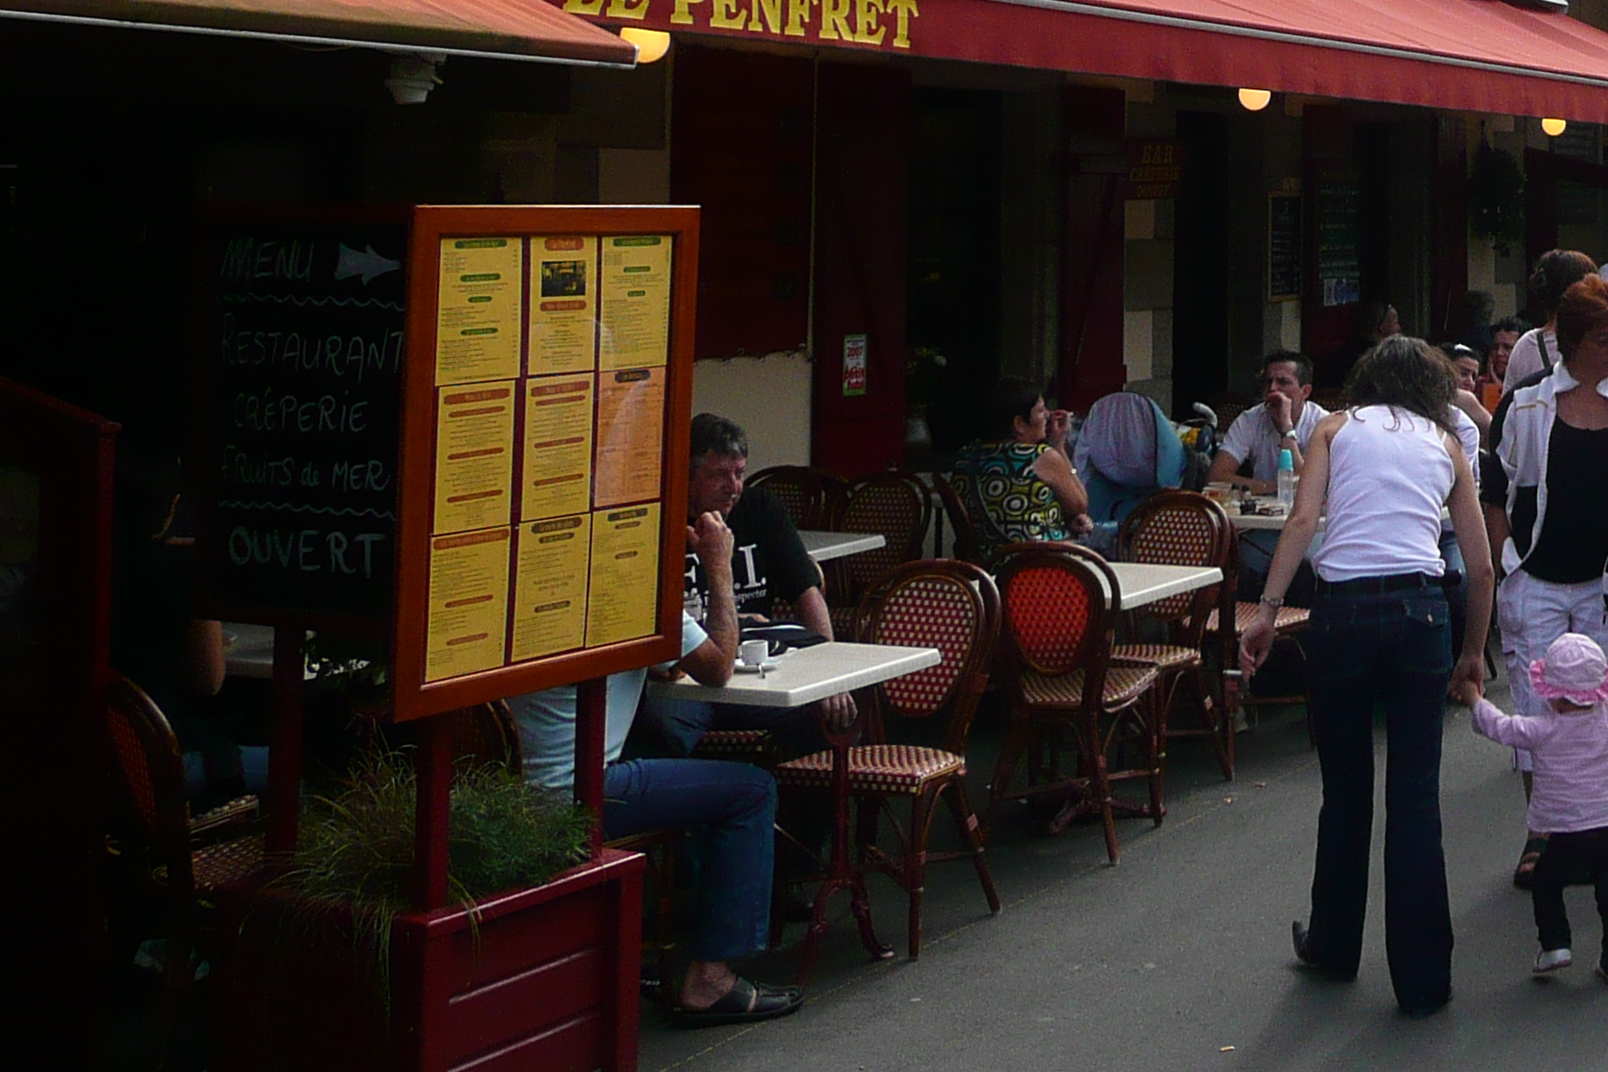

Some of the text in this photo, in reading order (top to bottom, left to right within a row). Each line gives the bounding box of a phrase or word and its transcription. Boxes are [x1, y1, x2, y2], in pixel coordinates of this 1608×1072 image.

[1140, 144, 1173, 164] BAR
[219, 237, 315, 283] MENU
[220, 312, 404, 384] RESTAURANT
[300, 460, 321, 488] de
[331, 458, 392, 493] MER
[228, 524, 386, 579] OUVERT
